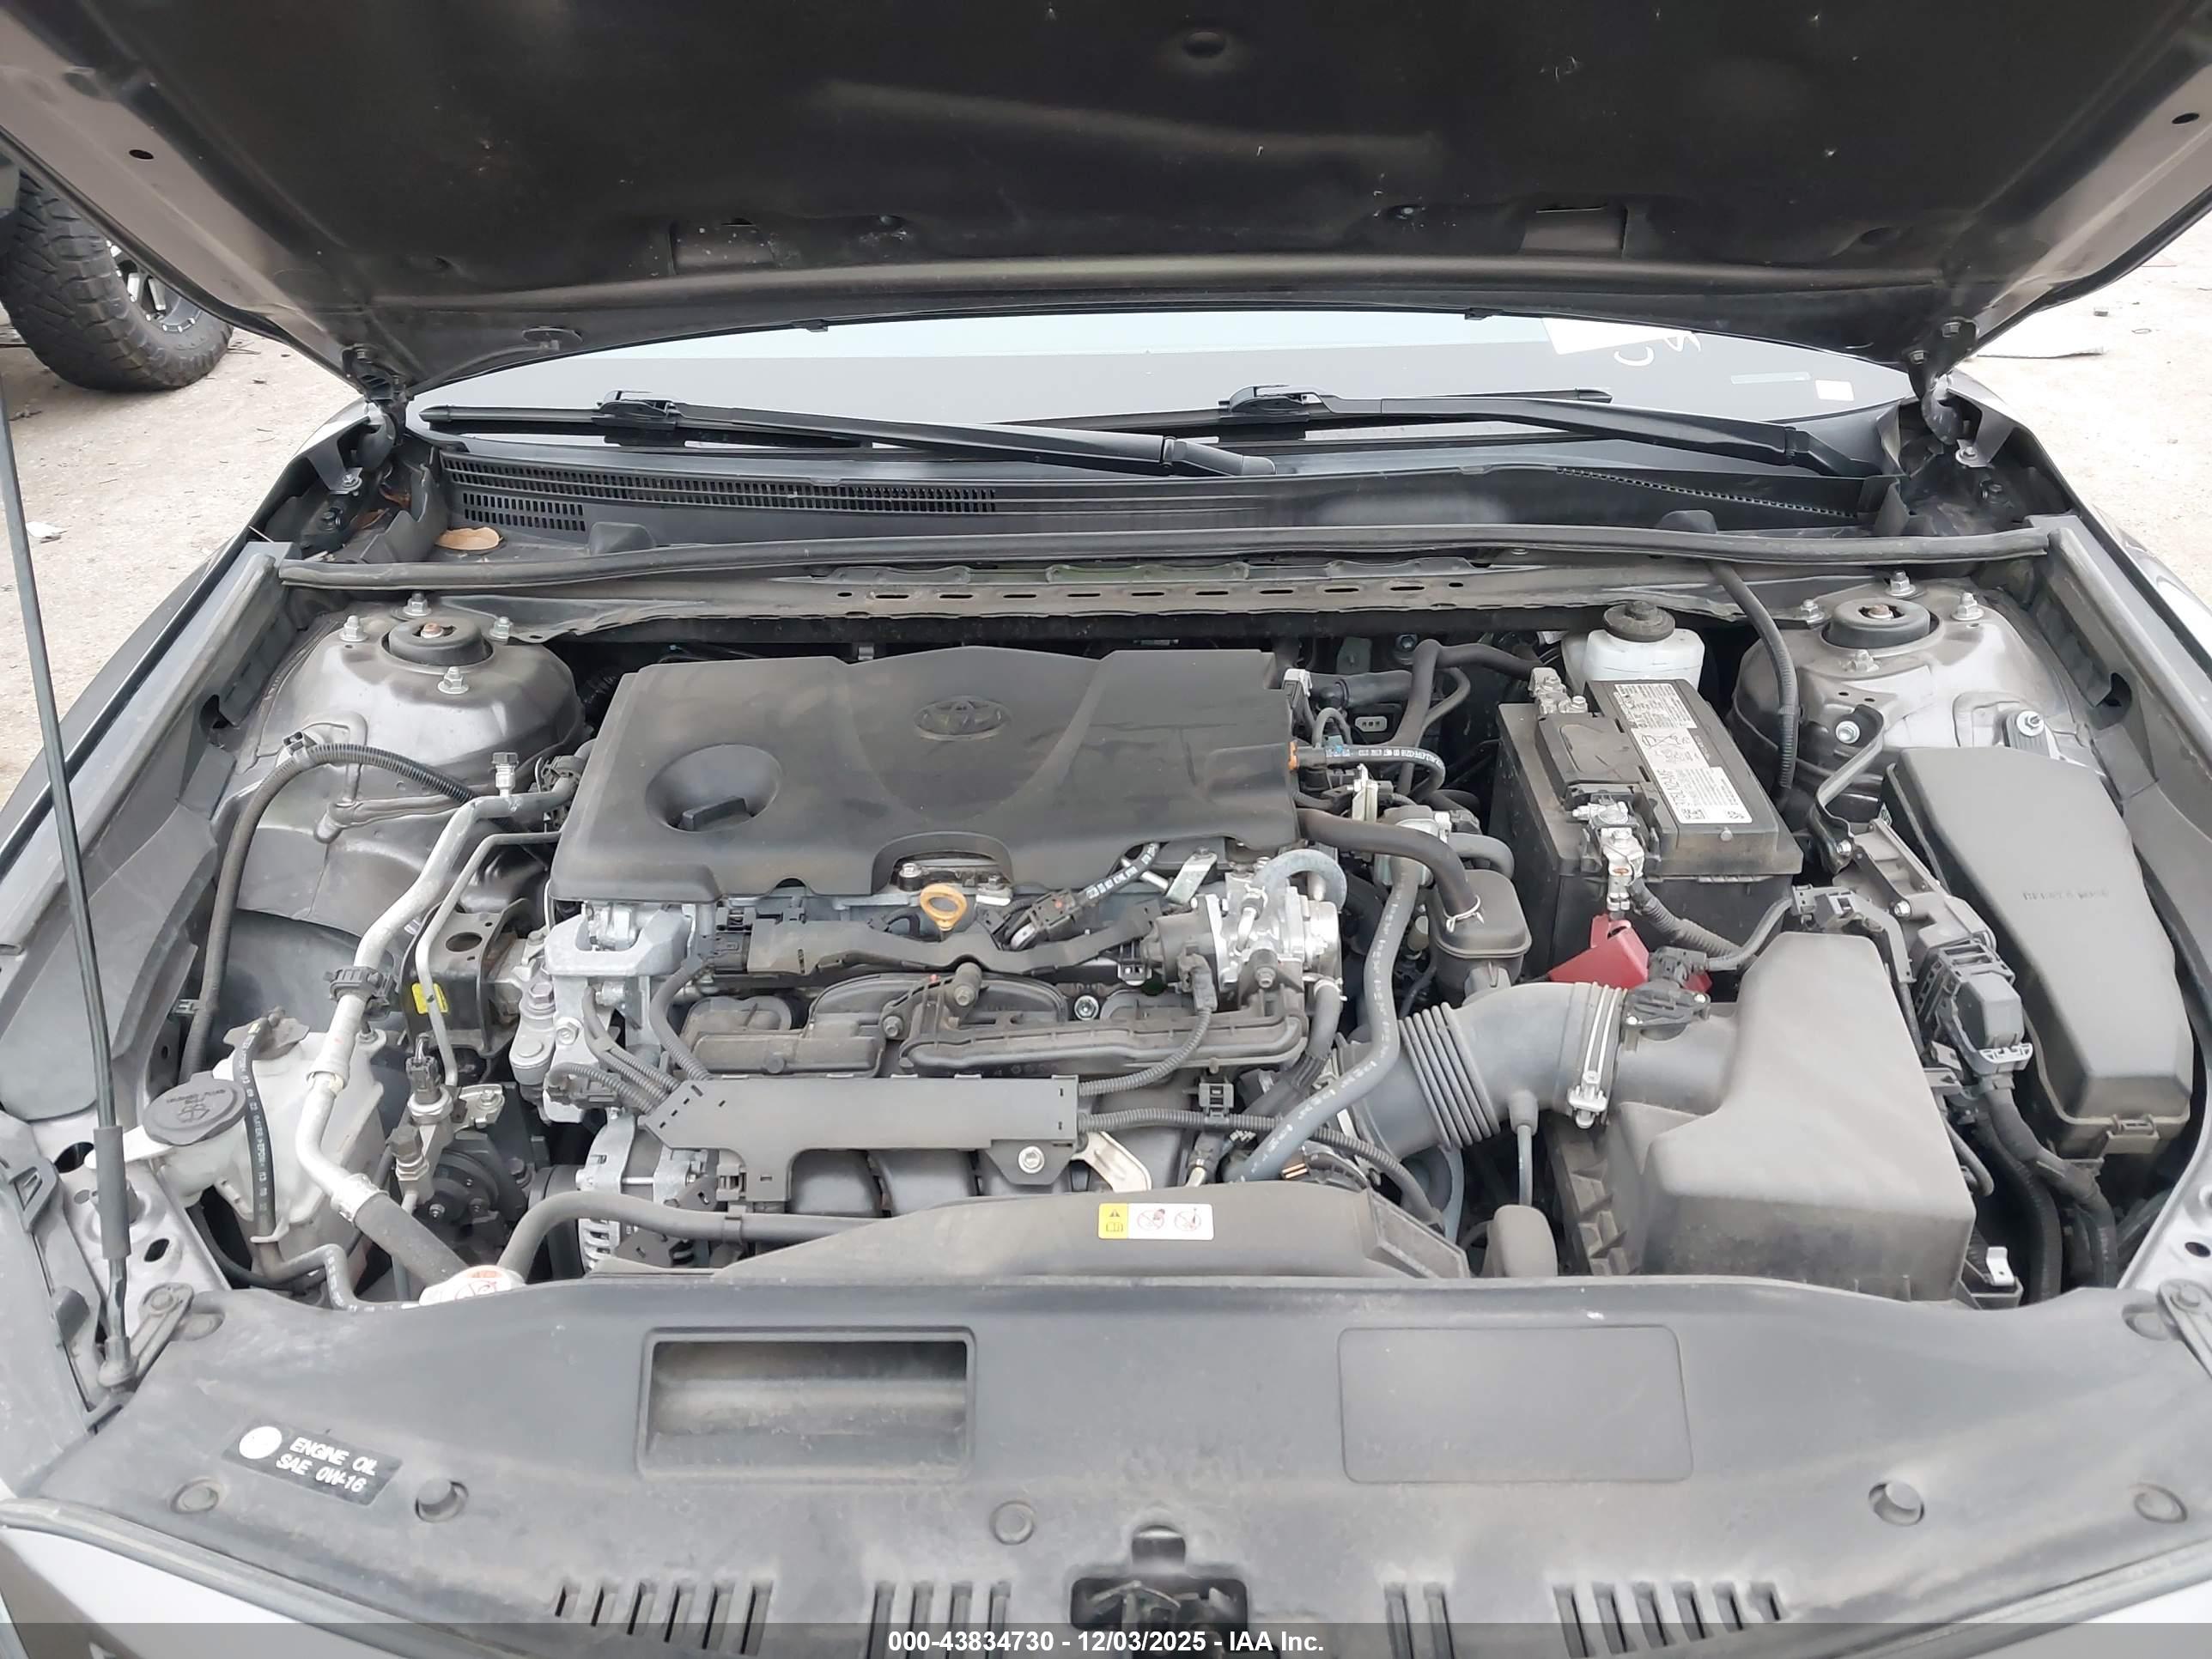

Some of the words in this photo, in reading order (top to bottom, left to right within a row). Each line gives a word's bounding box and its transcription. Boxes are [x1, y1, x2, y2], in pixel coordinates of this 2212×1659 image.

[276, 1453, 313, 1475] SAE
[315, 1466, 367, 1493] 0W-16
[289, 1436, 349, 1466] ENGINE
[352, 1456, 379, 1476] OIL
